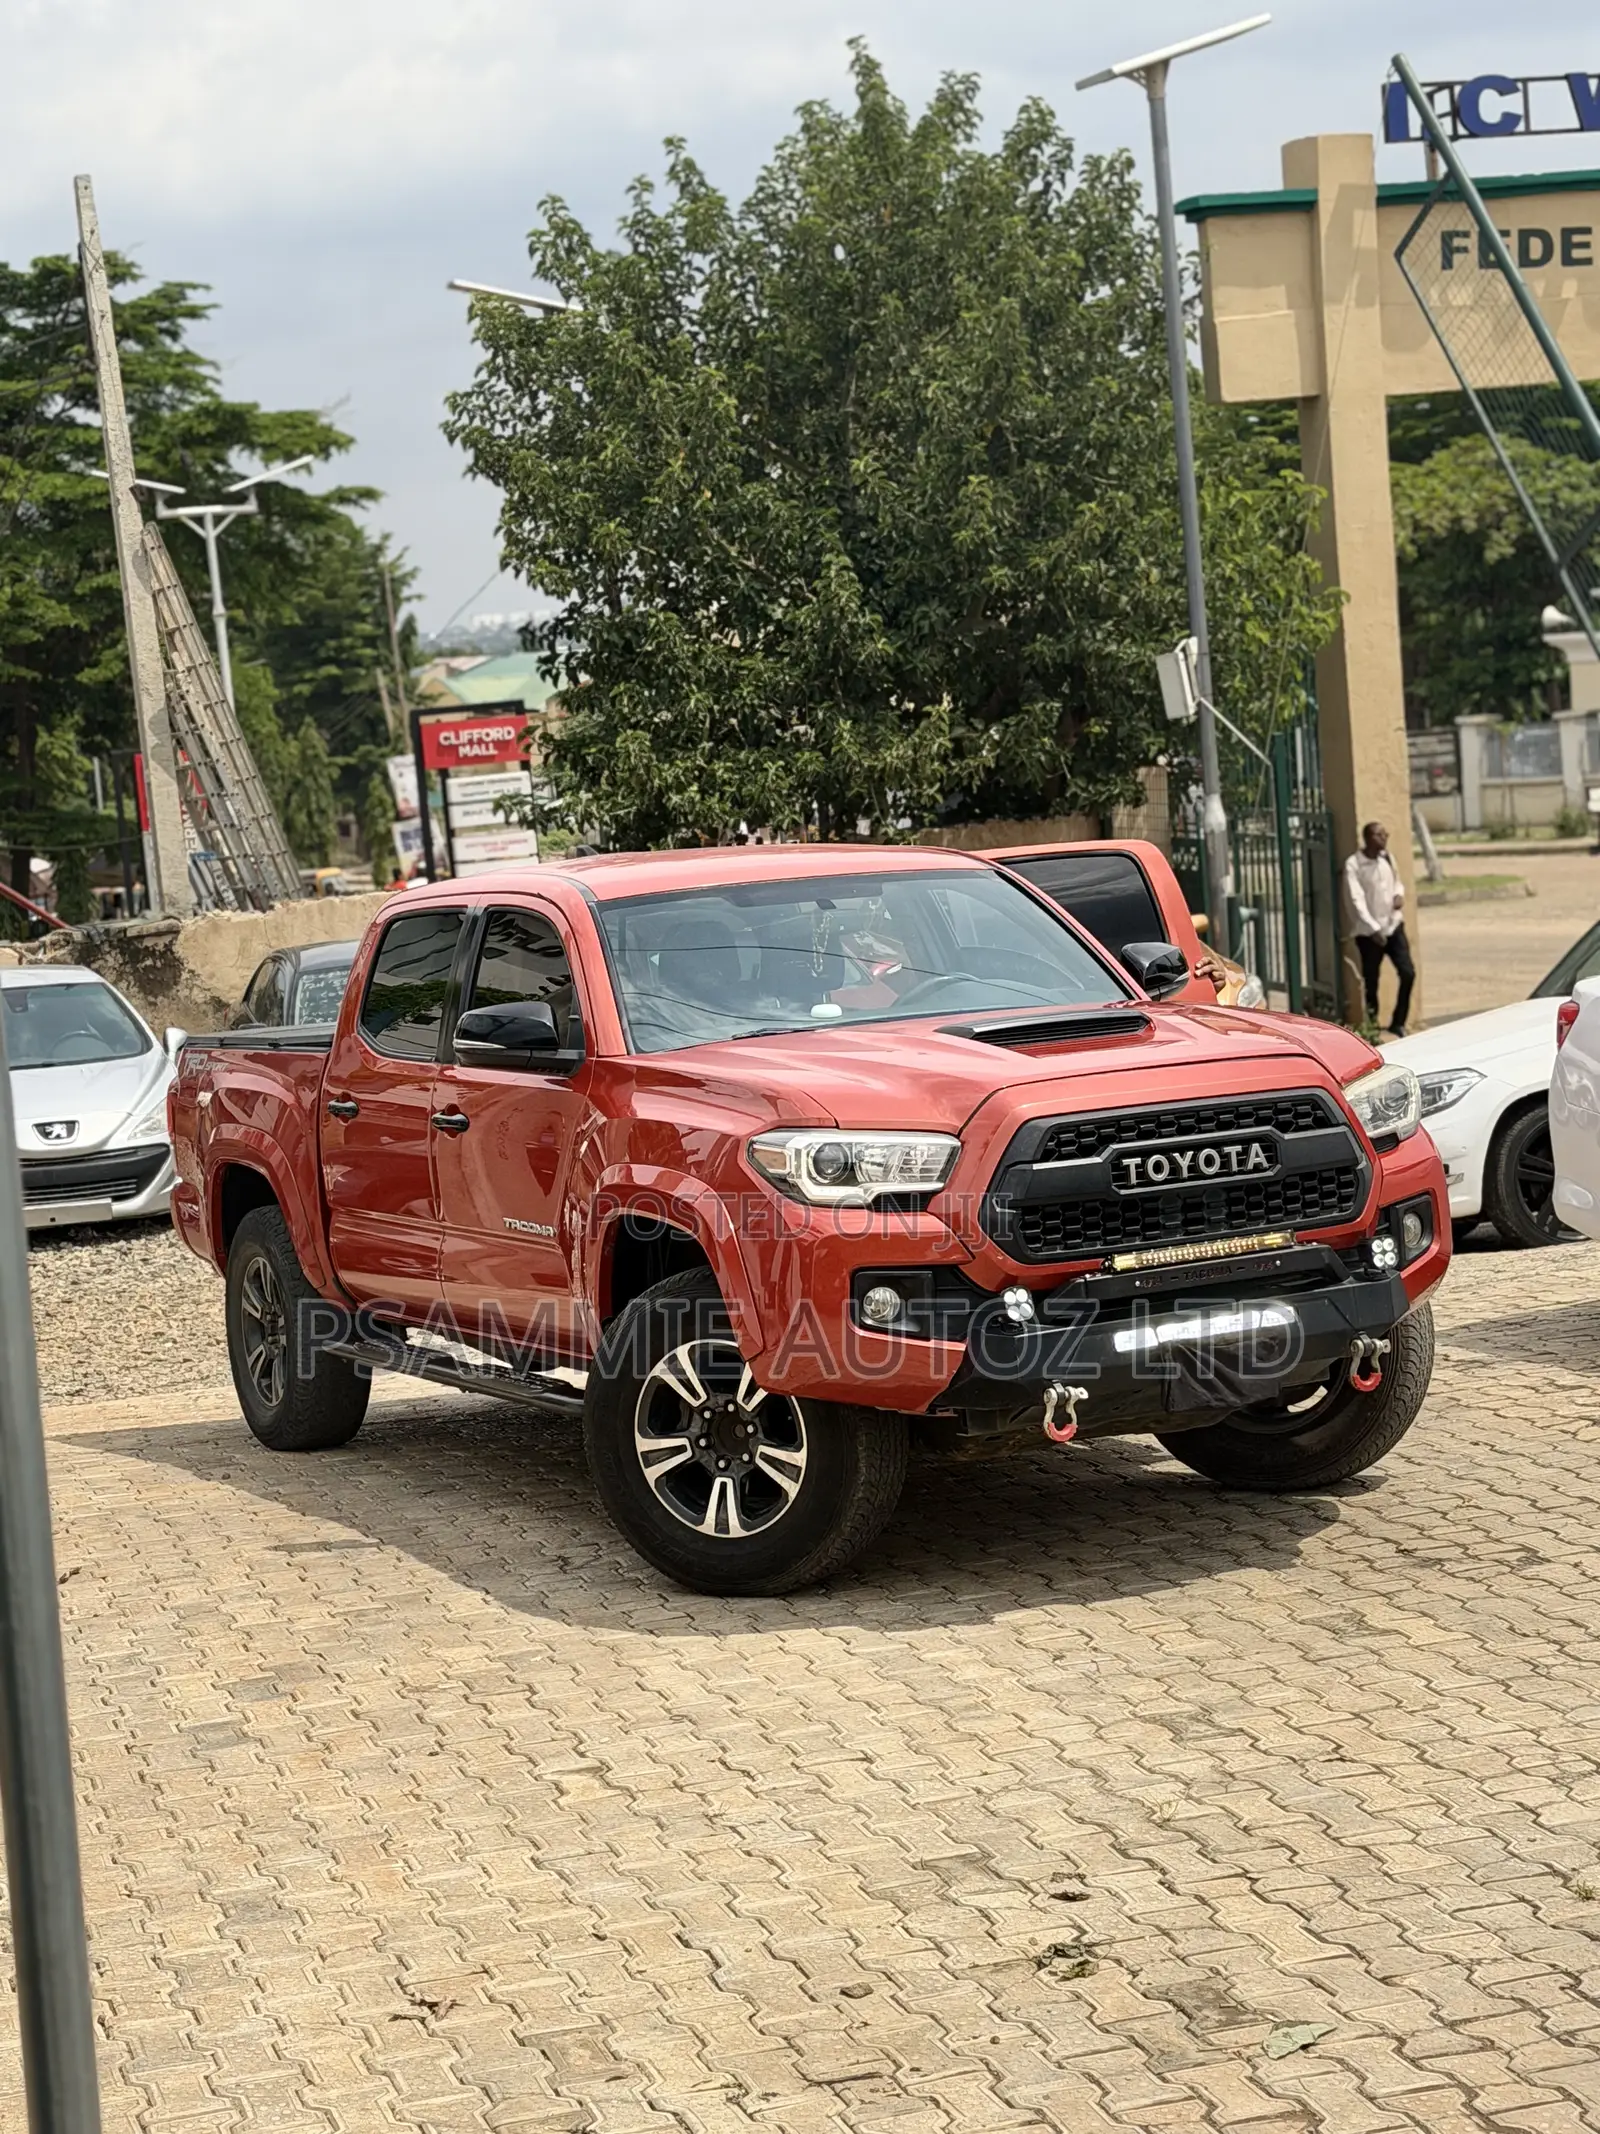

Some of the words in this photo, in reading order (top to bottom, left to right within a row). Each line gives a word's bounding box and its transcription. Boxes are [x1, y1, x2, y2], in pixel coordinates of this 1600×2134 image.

[438, 726, 516, 747] CLIFFORD
[458, 743, 499, 758] MALL
[184, 1053, 209, 1078] TRD
[205, 1061, 230, 1072] SPORT
[1121, 1142, 1270, 1186] TOYOTA
[502, 1216, 556, 1238] TACOMA
[1183, 1265, 1233, 1282] TACOMA
